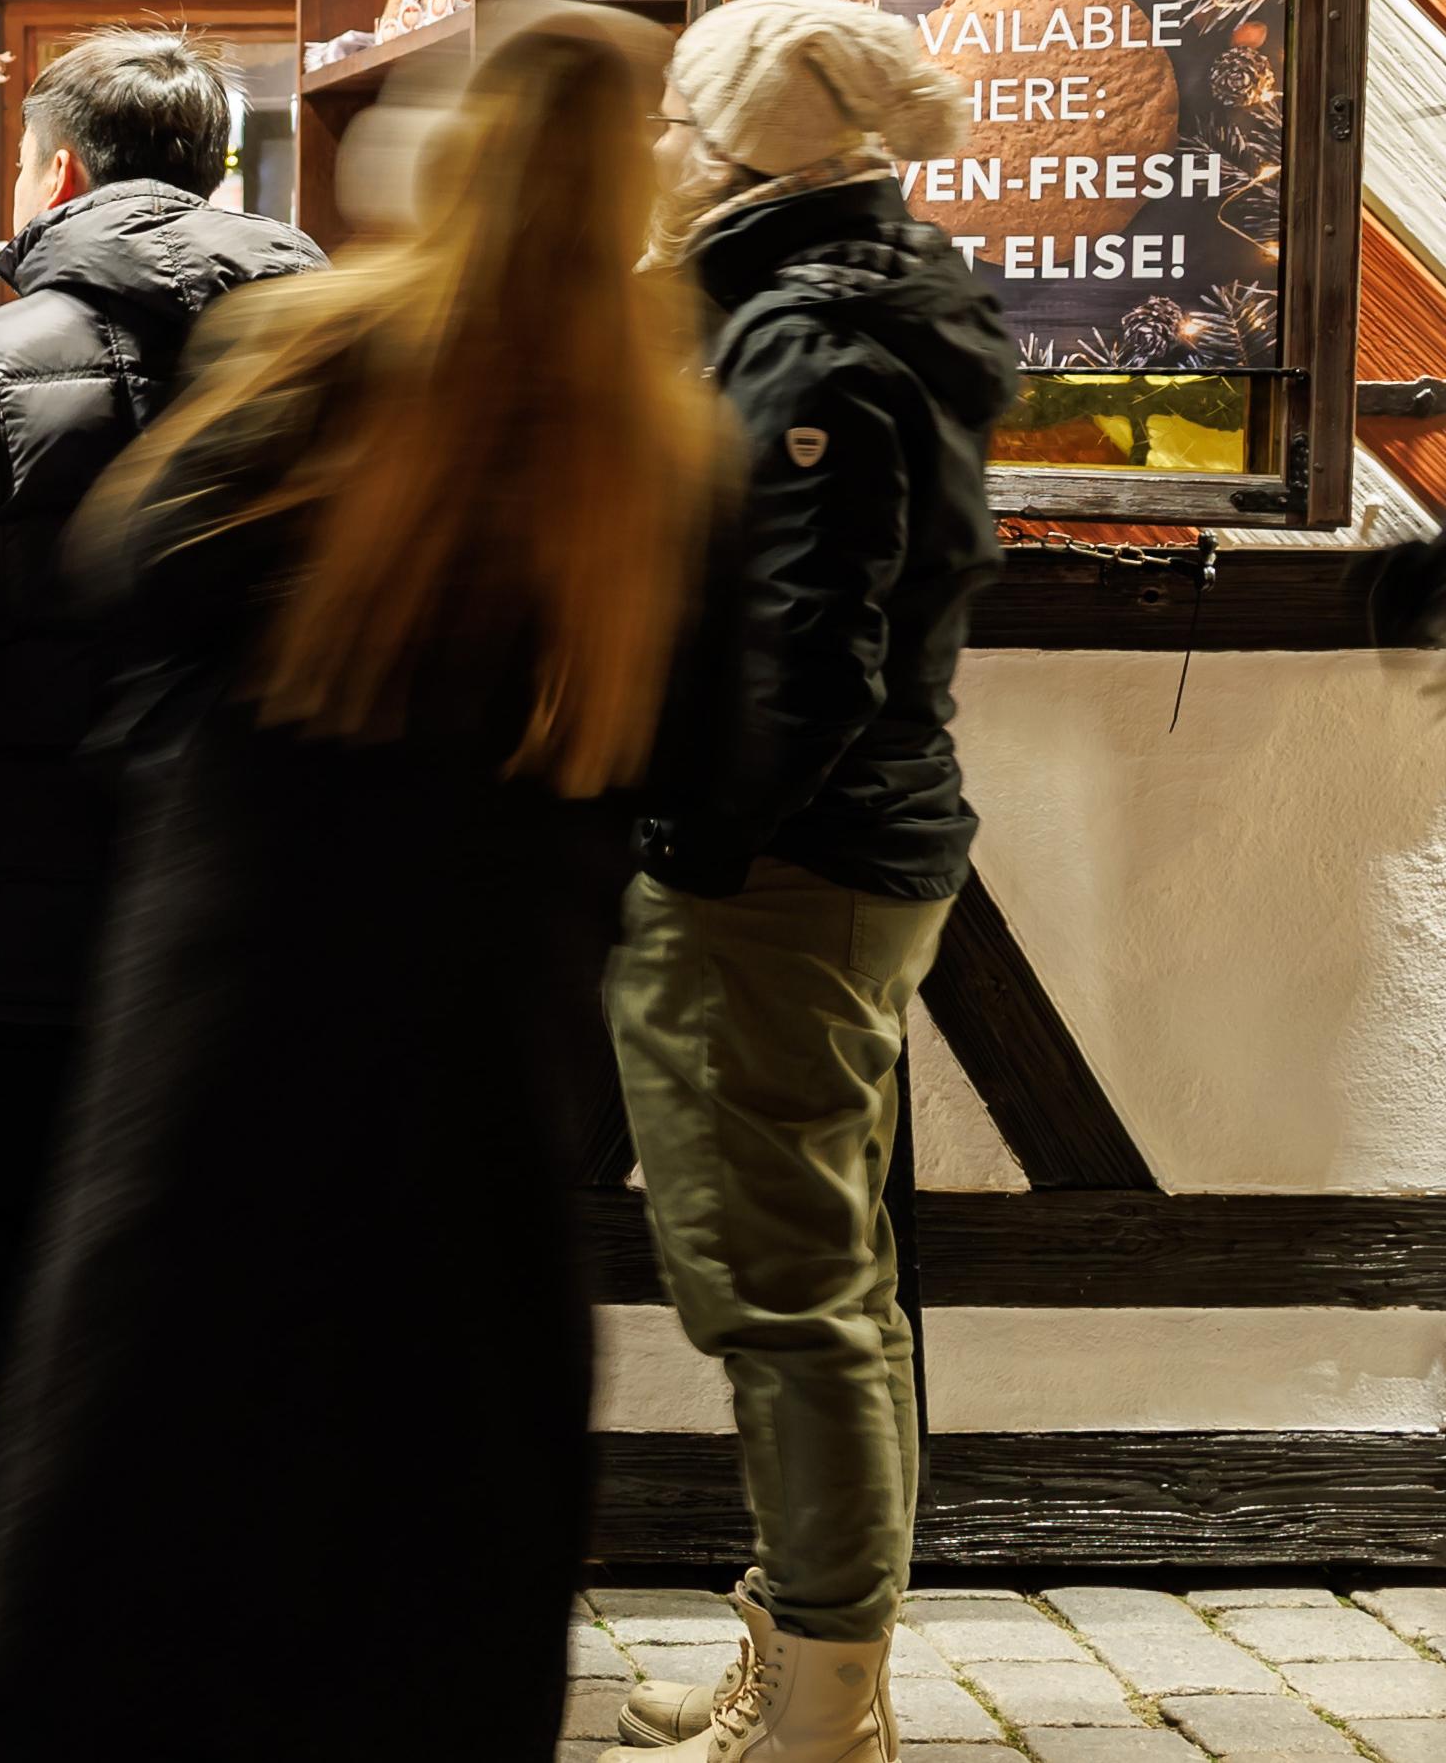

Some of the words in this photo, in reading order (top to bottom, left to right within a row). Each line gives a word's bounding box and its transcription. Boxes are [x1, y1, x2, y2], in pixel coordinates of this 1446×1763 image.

[917, 2, 1182, 56] VAILABLE
[891, 153, 1221, 202] VEN-FRESH
[1004, 234, 1185, 280] ELISE!
